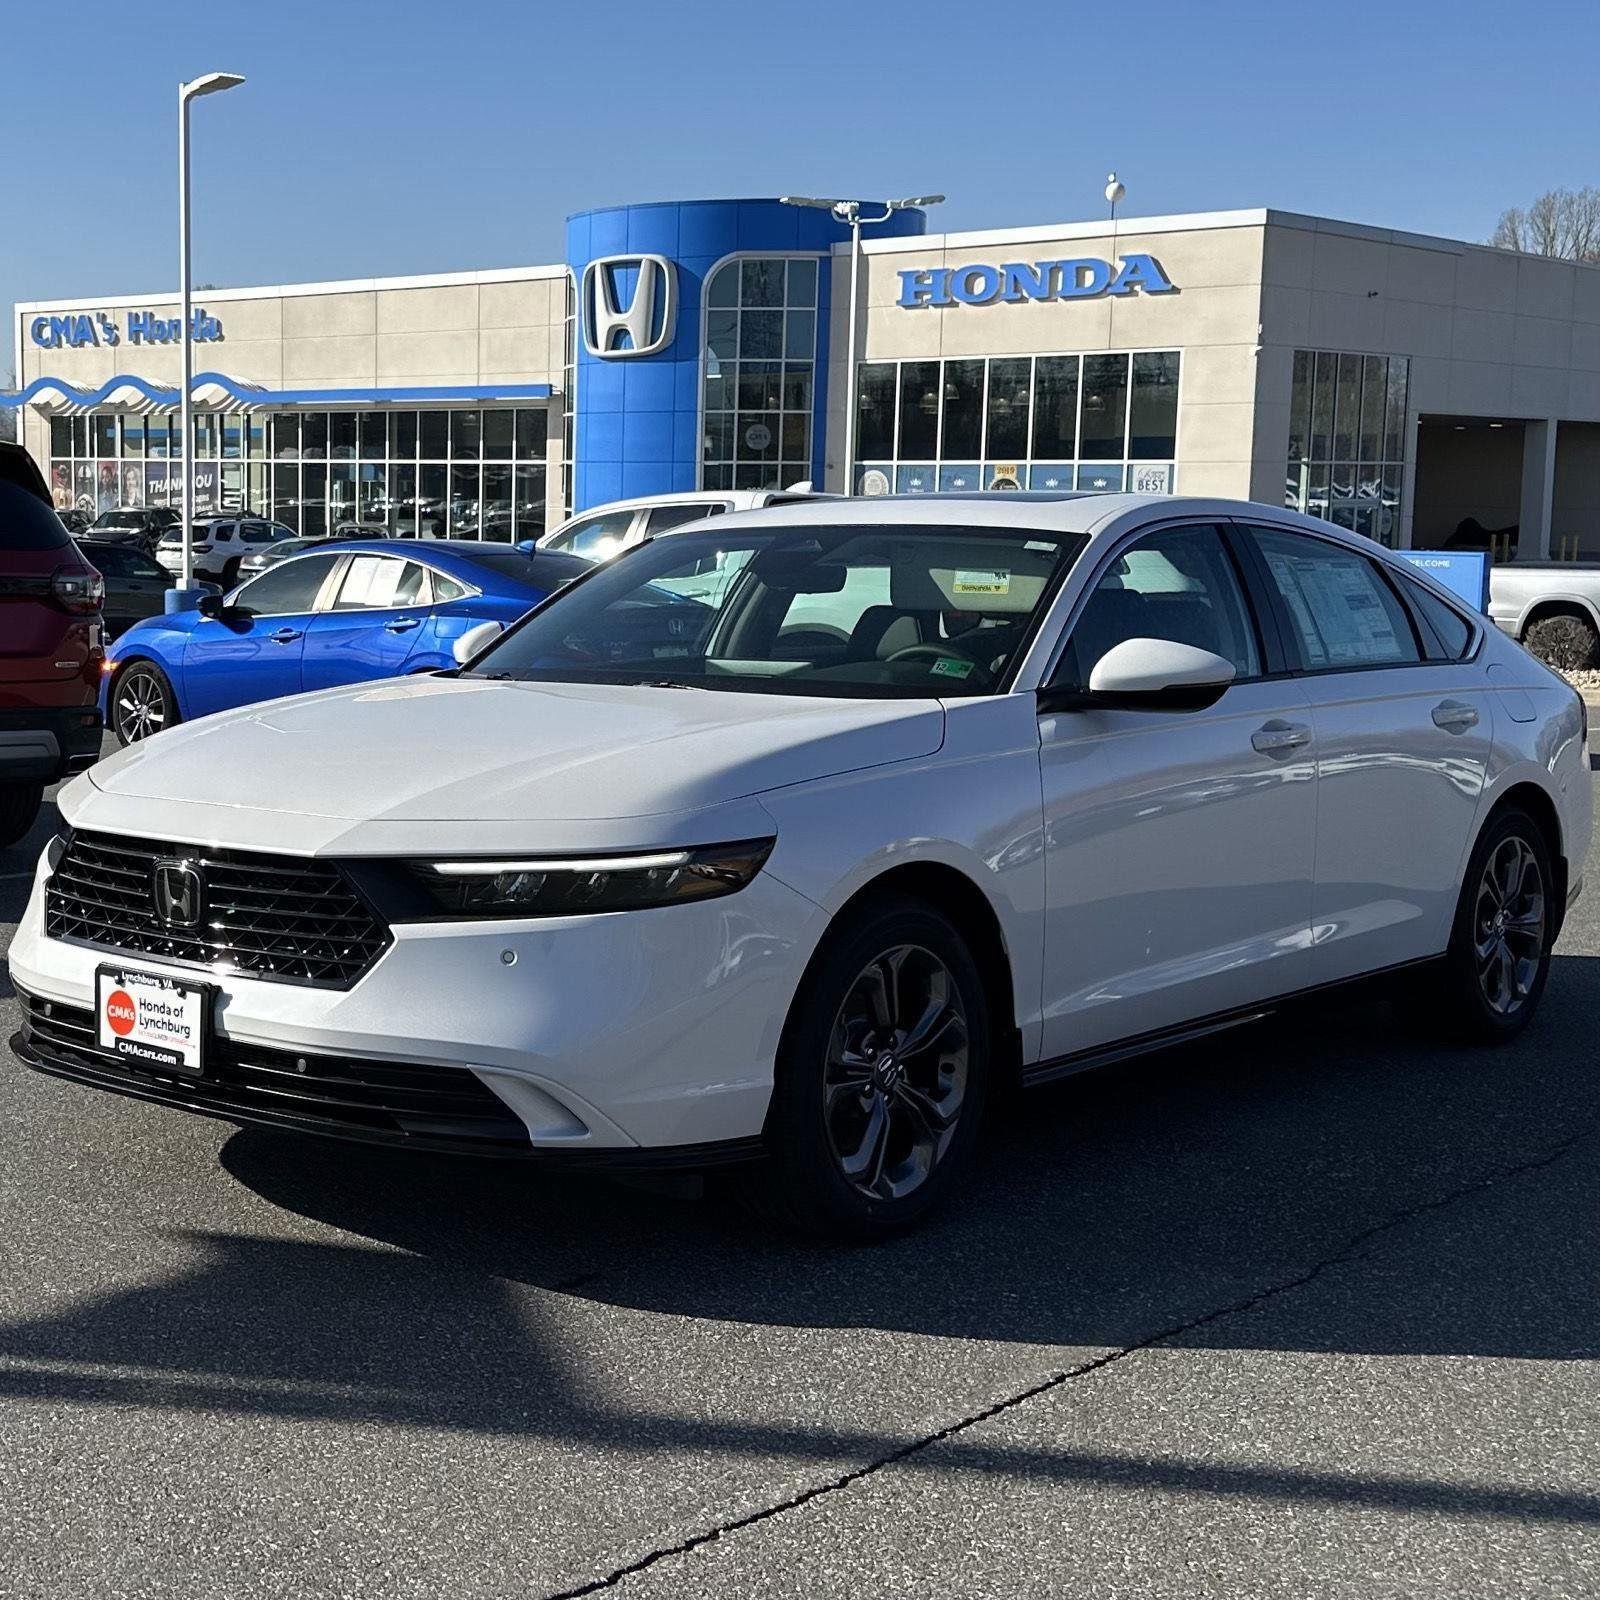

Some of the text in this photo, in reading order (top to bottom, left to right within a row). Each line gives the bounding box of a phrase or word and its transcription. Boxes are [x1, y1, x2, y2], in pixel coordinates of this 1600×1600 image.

[896, 254, 1179, 309] HONDA
[31, 308, 224, 348] CMA's Honda
[997, 466, 1015, 475] 2019
[1138, 479, 1165, 491] BEST
[162, 979, 174, 989] VA
[107, 1005, 135, 1020] CMA's
[139, 998, 184, 1019] Honda of
[139, 1013, 191, 1039] Lynchburg
[119, 1042, 177, 1064] CMAcars.com
